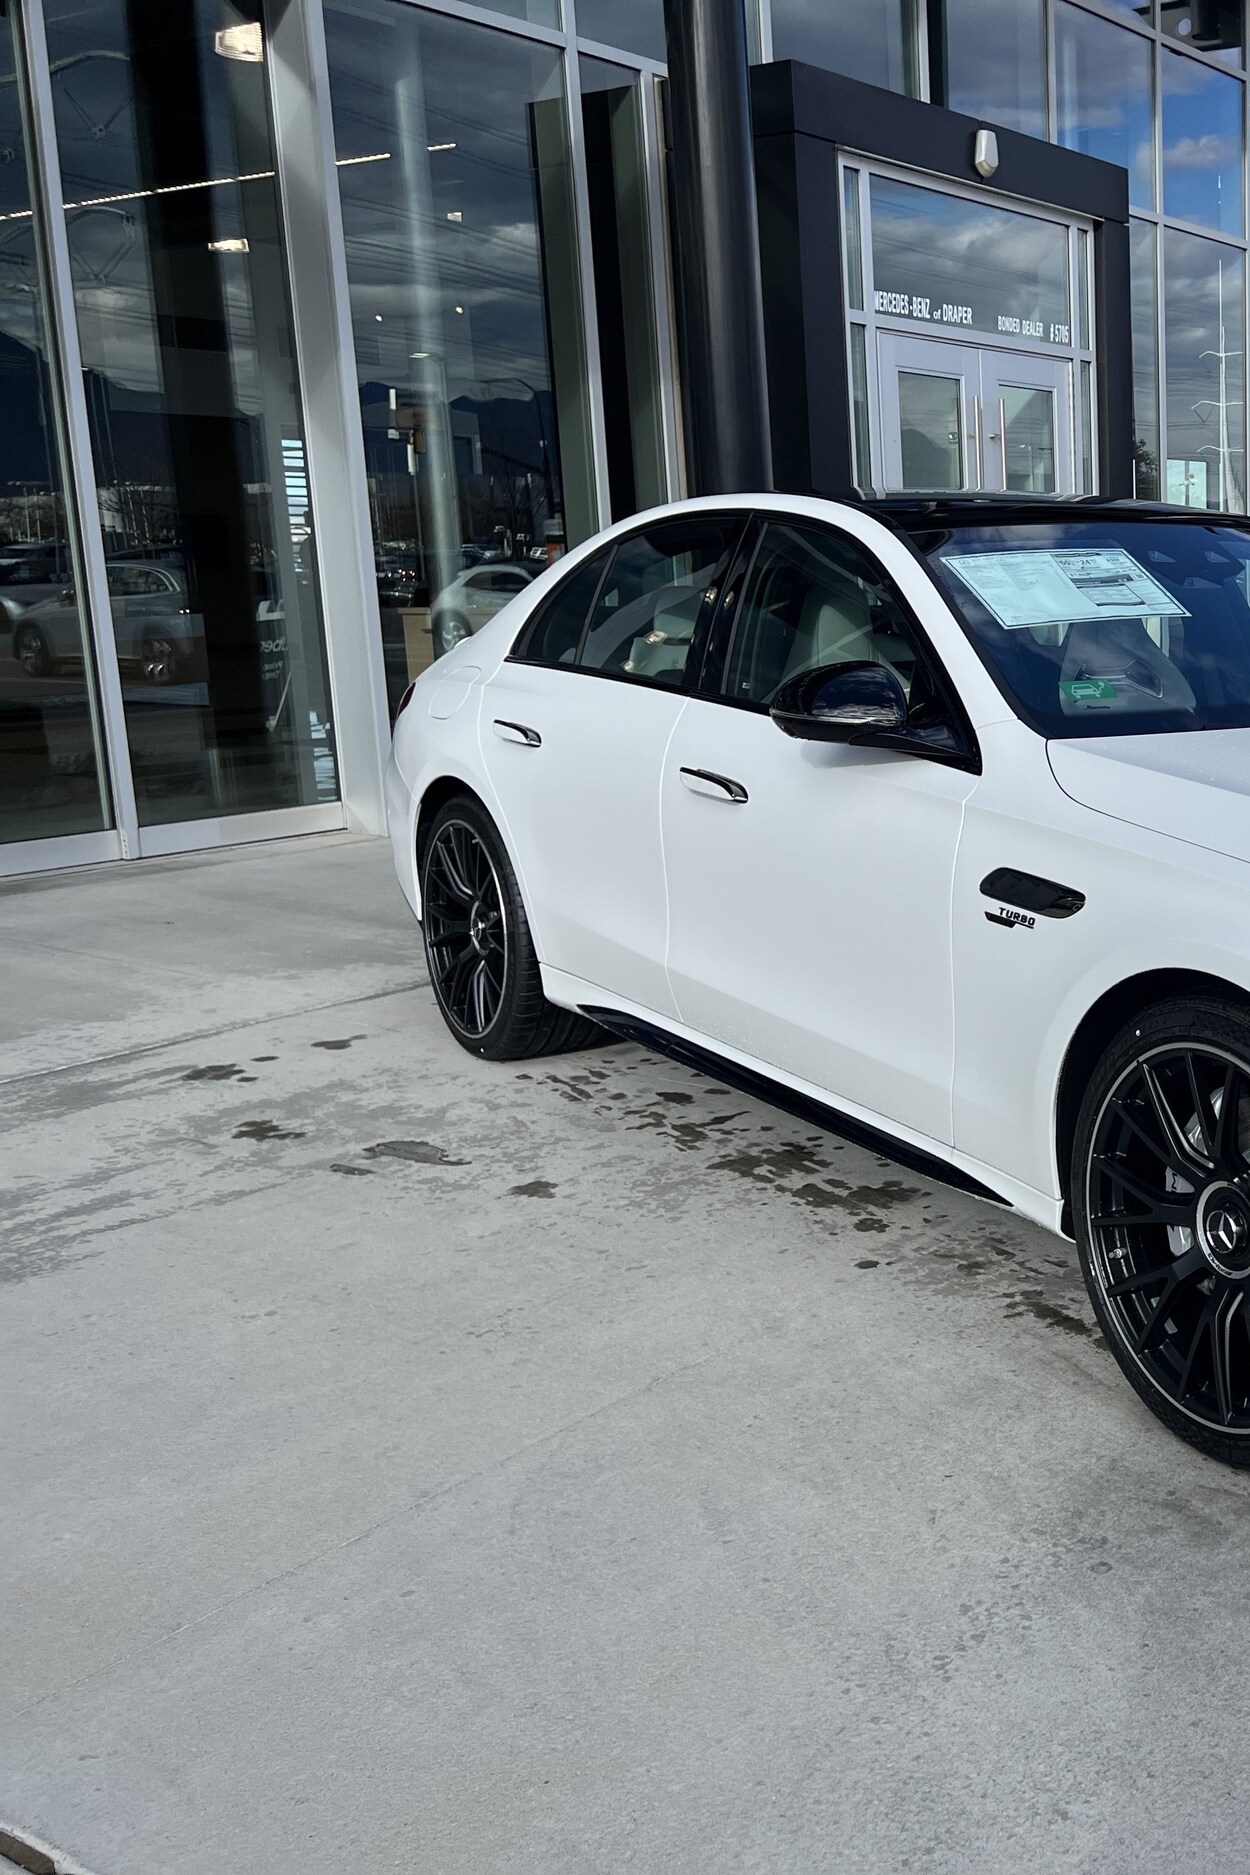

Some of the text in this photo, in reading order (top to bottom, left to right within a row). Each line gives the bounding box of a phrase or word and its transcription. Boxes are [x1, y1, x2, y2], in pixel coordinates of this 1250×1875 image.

[933, 309, 941, 320] of
[942, 304, 973, 325] DRAPER
[997, 315, 1020, 333] BONDED
[1022, 320, 1044, 337] DEALER
[999, 907, 1036, 926] TURBO
